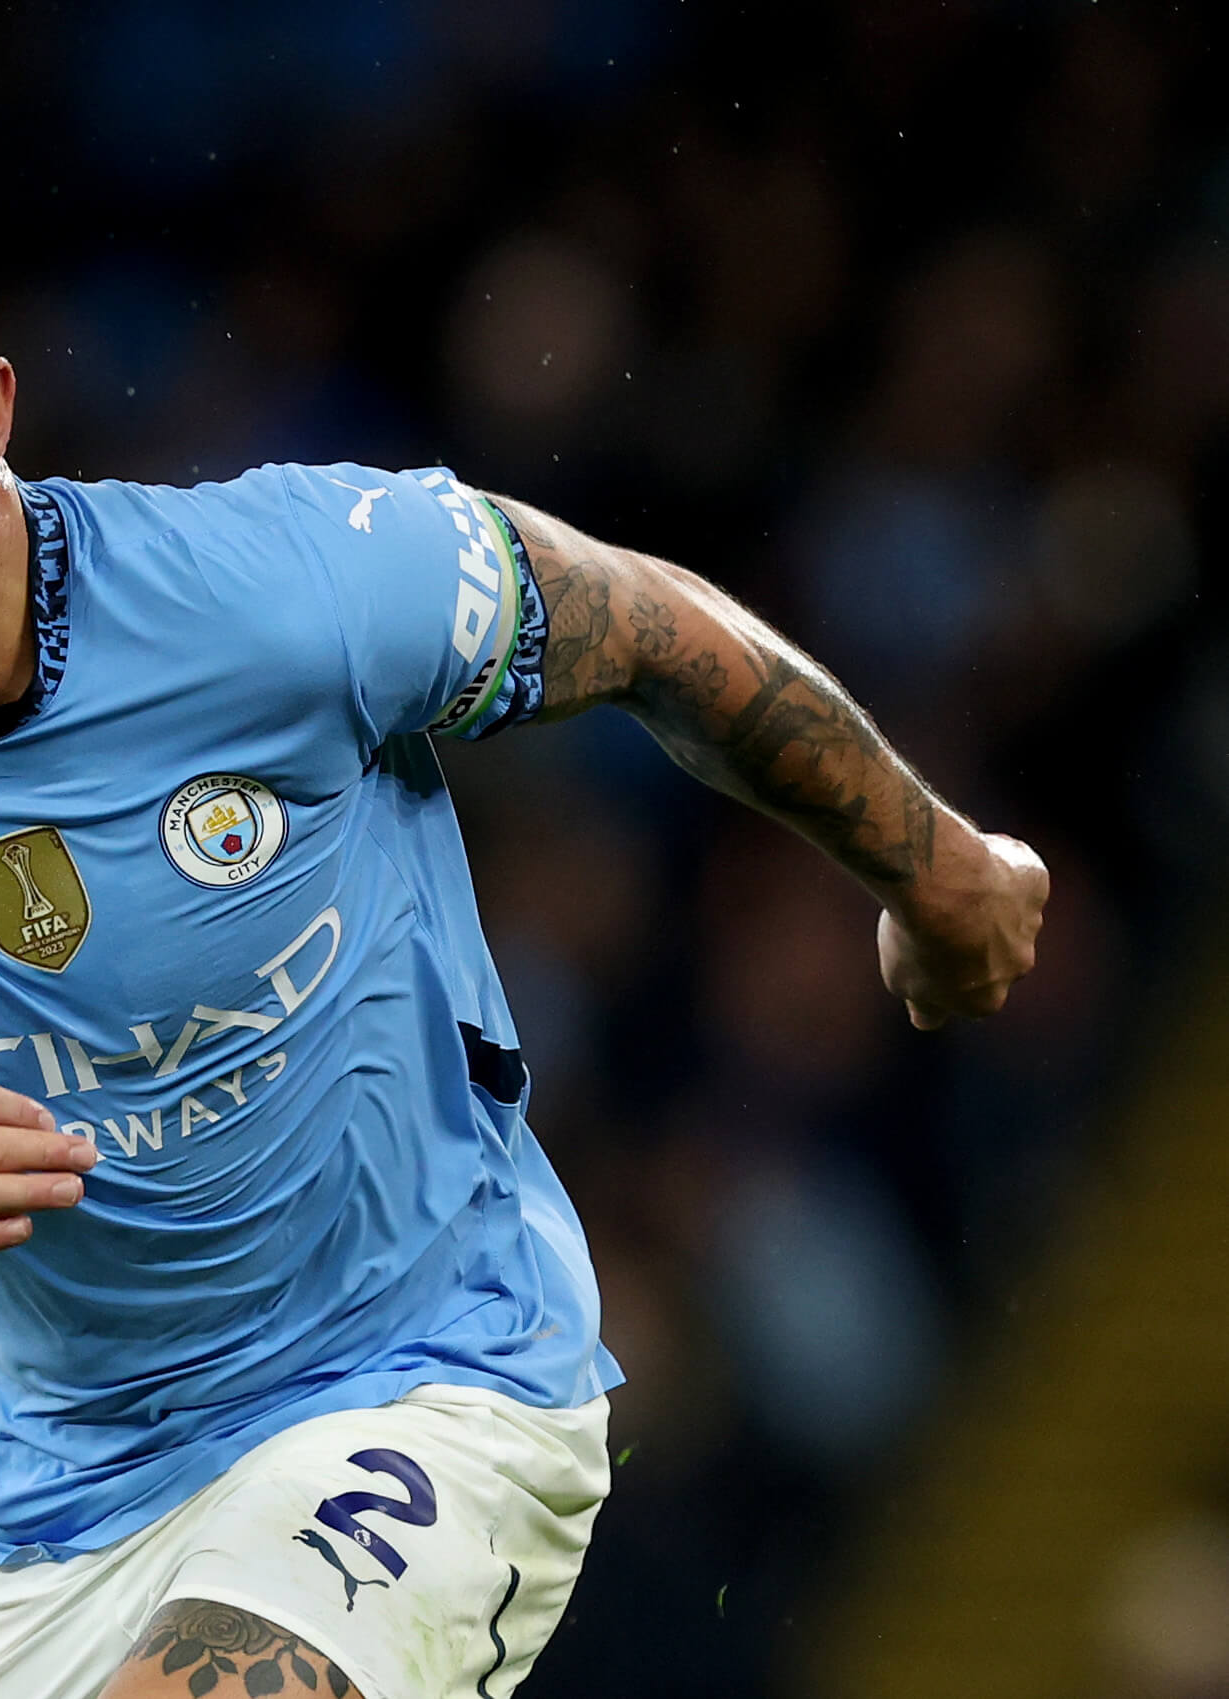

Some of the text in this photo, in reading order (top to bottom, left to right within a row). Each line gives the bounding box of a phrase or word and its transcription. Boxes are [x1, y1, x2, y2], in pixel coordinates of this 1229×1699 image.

[427, 658, 497, 733] tain
[170, 778, 261, 831] MANCHESTER
[228, 857, 261, 881] CITY
[21, 914, 68, 943] FIFA
[38, 941, 66, 958] 2023
[60, 1051, 287, 1163] RWAYS
[314, 1447, 438, 1581] 2
